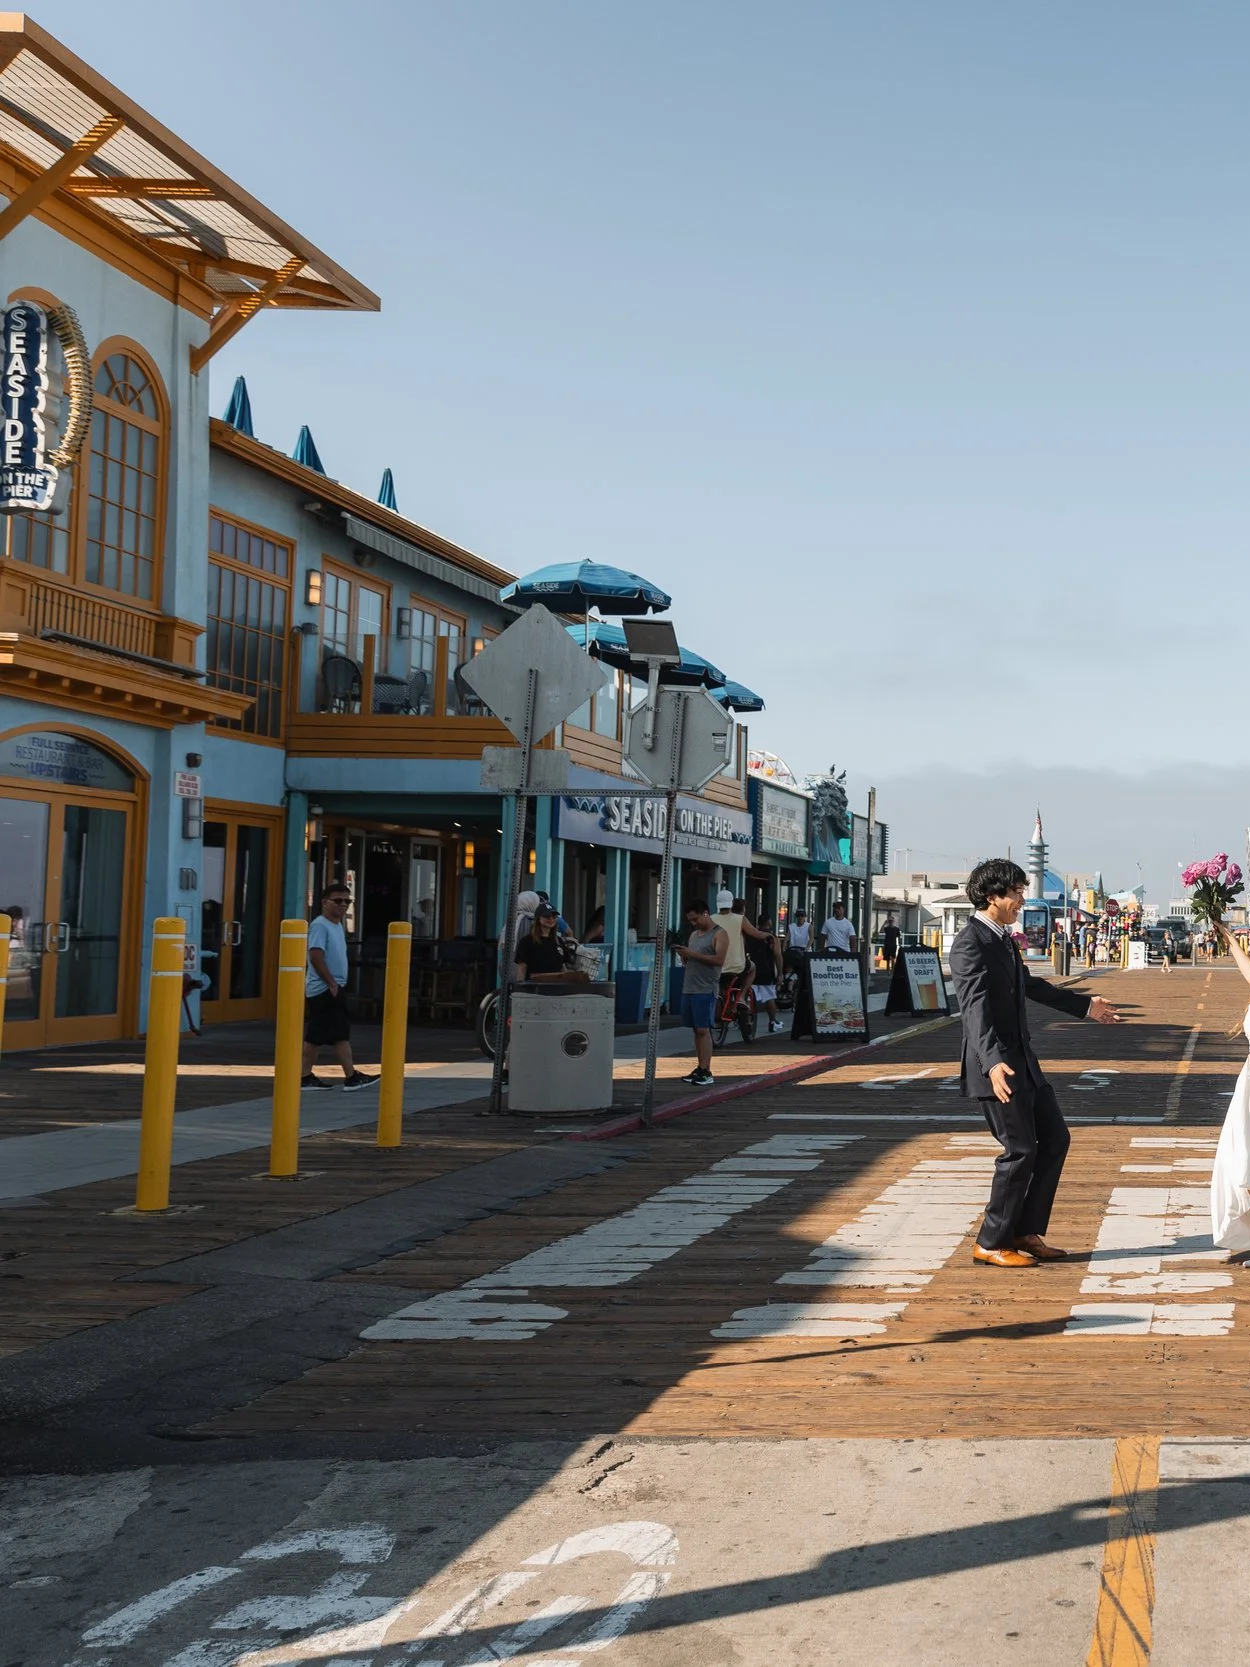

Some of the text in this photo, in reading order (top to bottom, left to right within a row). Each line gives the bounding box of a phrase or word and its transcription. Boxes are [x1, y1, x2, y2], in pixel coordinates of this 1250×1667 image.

[5, 308, 27, 464] SEASIDE
[0, 472, 44, 486] N THE
[3, 485, 33, 498] PIER
[16, 745, 77, 765] RESTAURANT
[29, 761, 88, 781] UPSTAIRS
[610, 796, 733, 841] SEASID ON THE PIER
[1106, 903, 1119, 911] STOP
[812, 972, 844, 980] Rooftop
